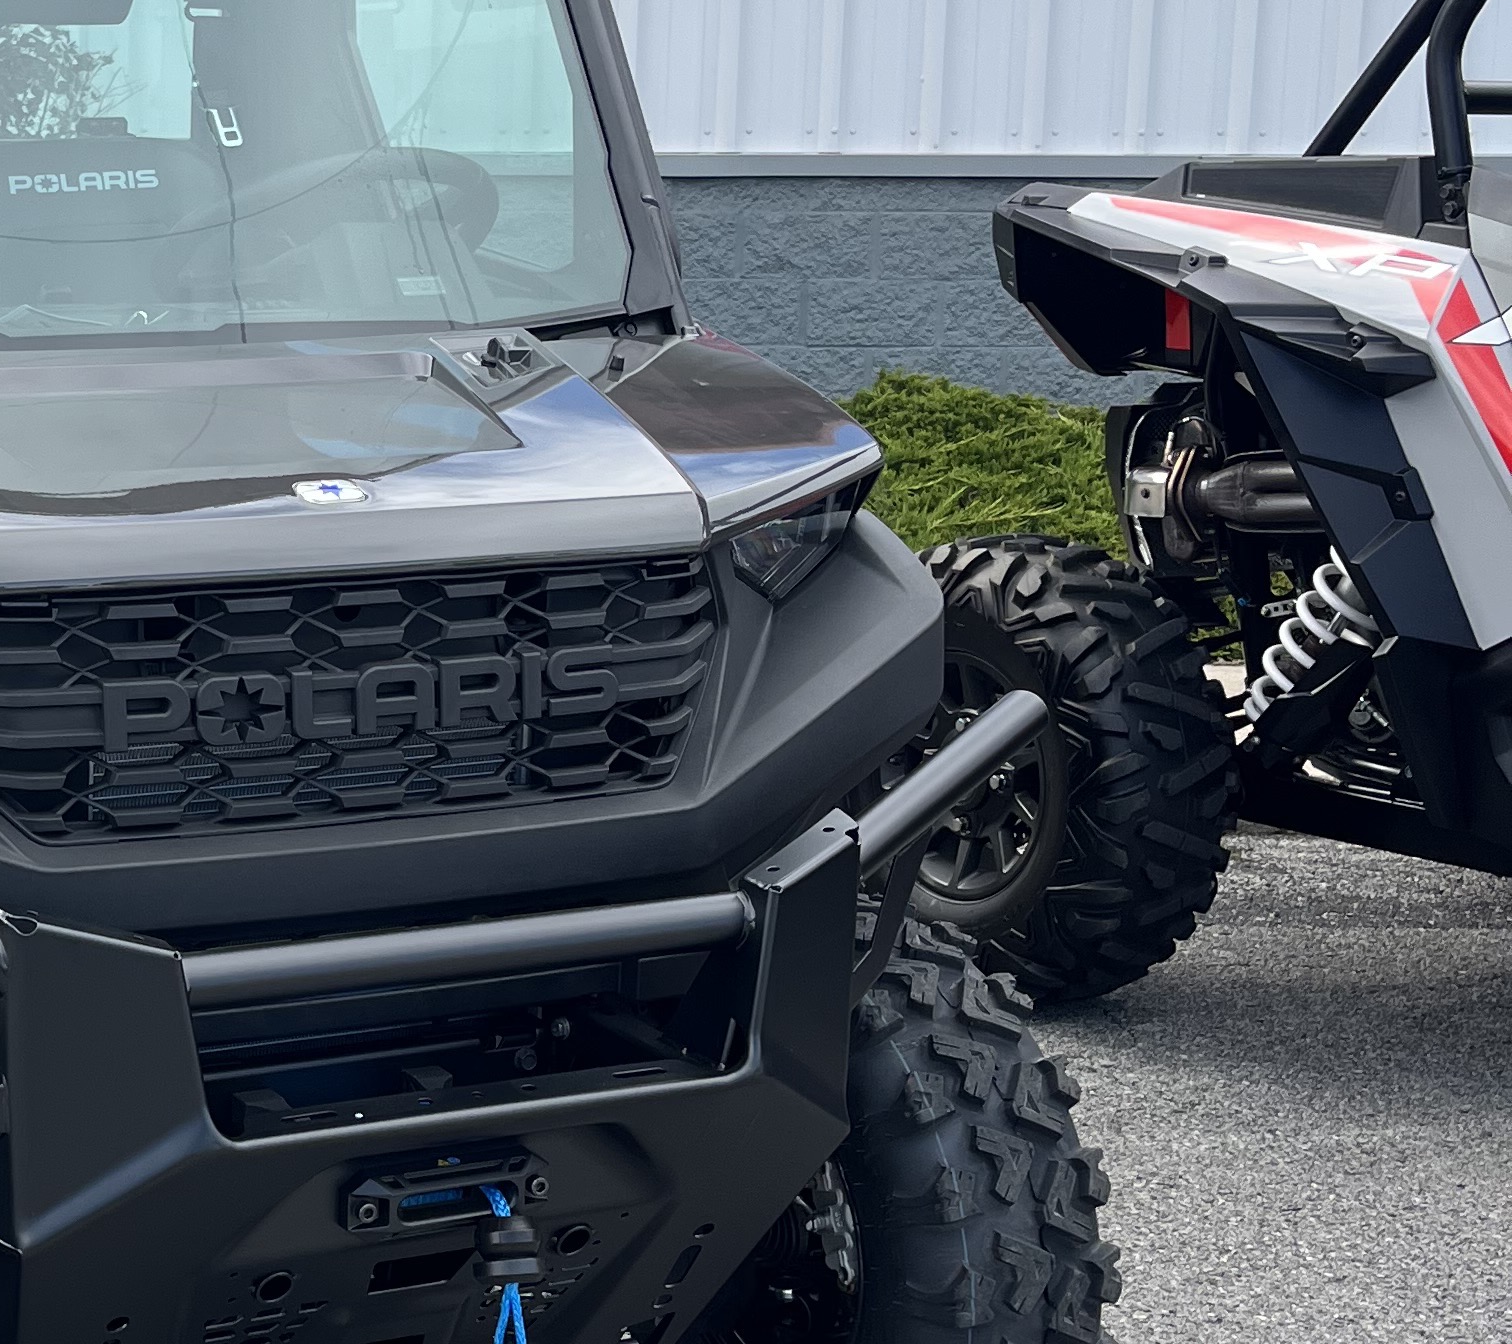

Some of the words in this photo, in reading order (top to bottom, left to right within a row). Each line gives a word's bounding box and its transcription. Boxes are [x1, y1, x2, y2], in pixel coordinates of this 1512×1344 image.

[8, 169, 159, 195] POLARIS
[1268, 241, 1454, 280] XP
[101, 645, 620, 753] POLARIS
